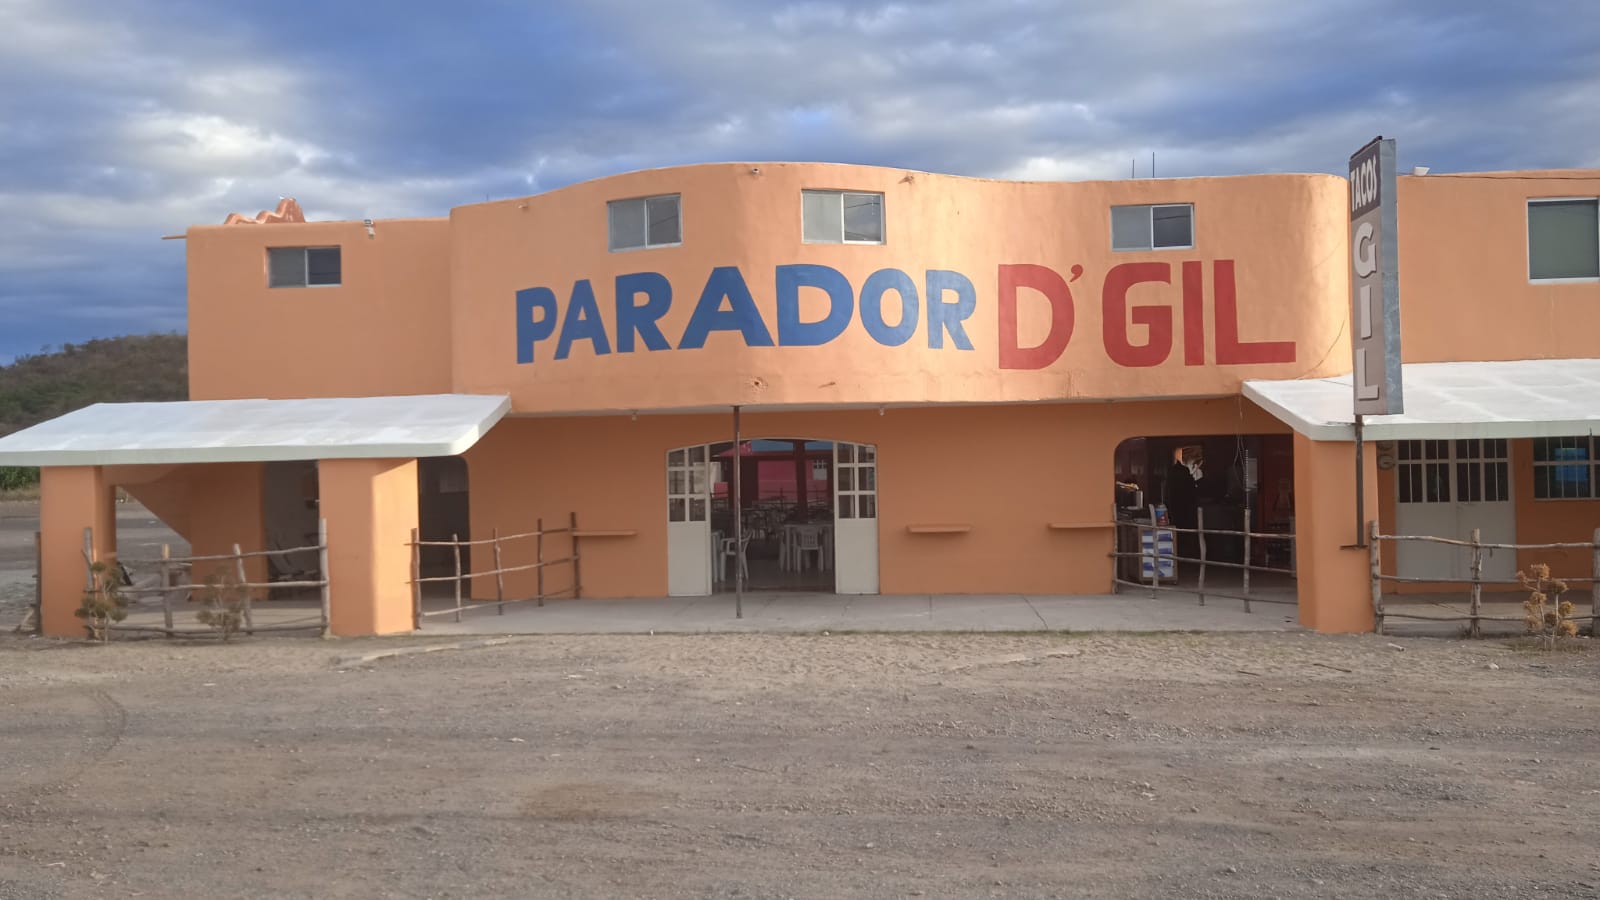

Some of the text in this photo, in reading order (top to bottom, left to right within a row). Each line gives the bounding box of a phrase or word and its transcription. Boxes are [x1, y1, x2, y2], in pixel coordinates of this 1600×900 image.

[1350, 154, 1378, 212] TACOS
[516, 263, 977, 364] PARADOR
[1353, 222, 1380, 400] GIL
